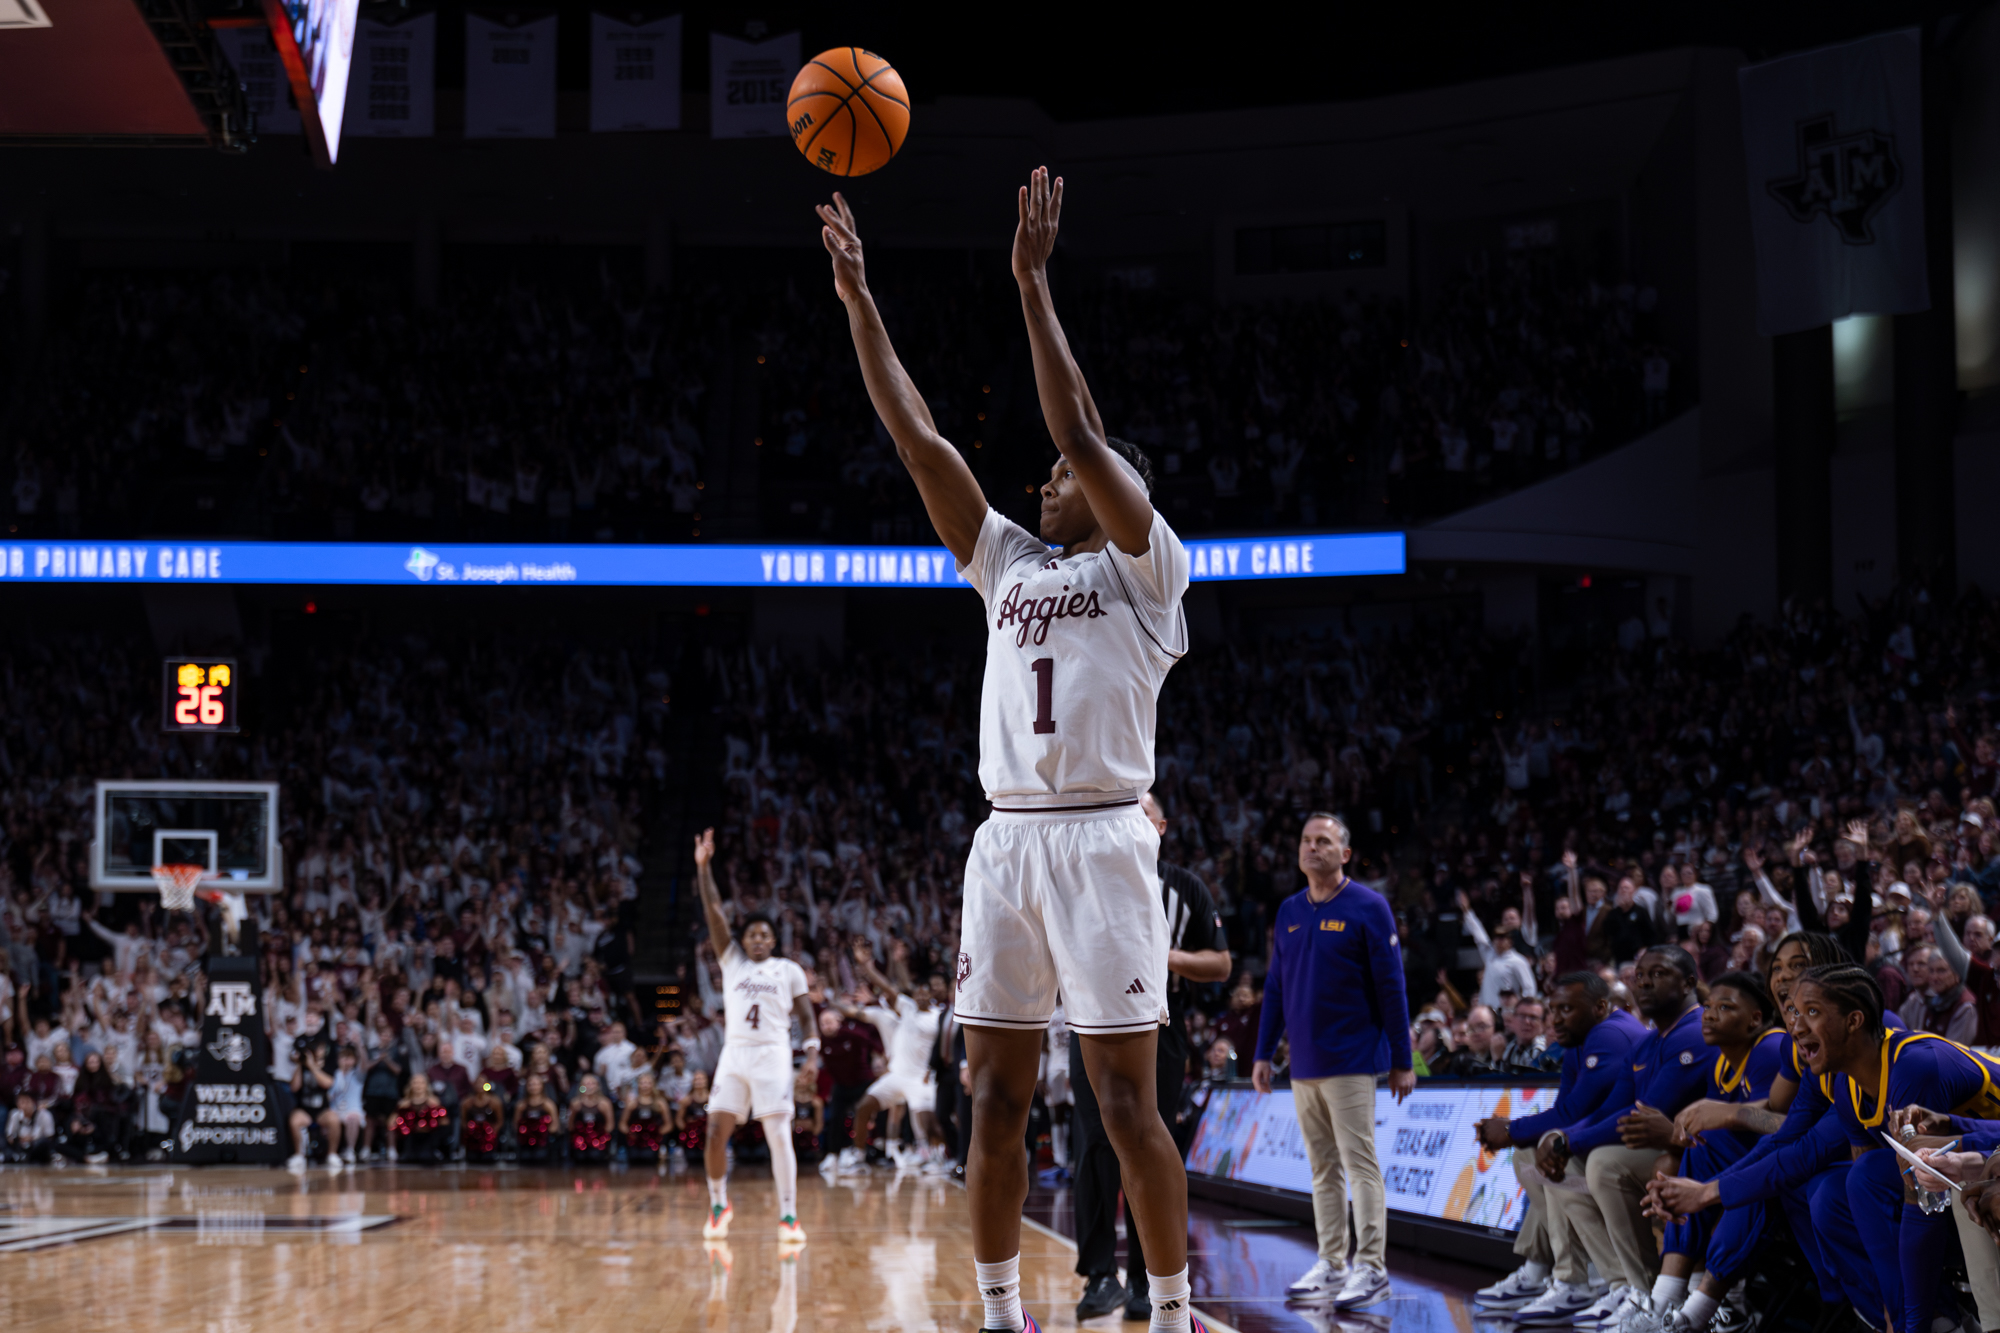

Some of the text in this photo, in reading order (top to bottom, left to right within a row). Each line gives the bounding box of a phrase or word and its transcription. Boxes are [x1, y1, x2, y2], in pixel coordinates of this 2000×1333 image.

[727, 79, 785, 105] 2015
[35, 546, 147, 578] PRIMARY
[158, 547, 222, 578] CARE
[761, 551, 825, 582] YOUR
[835, 551, 946, 583] PRIMARY
[1251, 542, 1314, 575] CARE
[462, 561, 519, 584] Joseph
[521, 561, 577, 581] Health
[997, 582, 1108, 649] Aggies
[175, 685, 224, 725] 26
[1031, 658, 1056, 735] 1
[1320, 919, 1346, 932] LSU
[734, 977, 778, 1000] Aggies
[745, 1004, 759, 1029] 4
[194, 1083, 267, 1104] WELLS
[195, 1104, 267, 1123] FARGO
